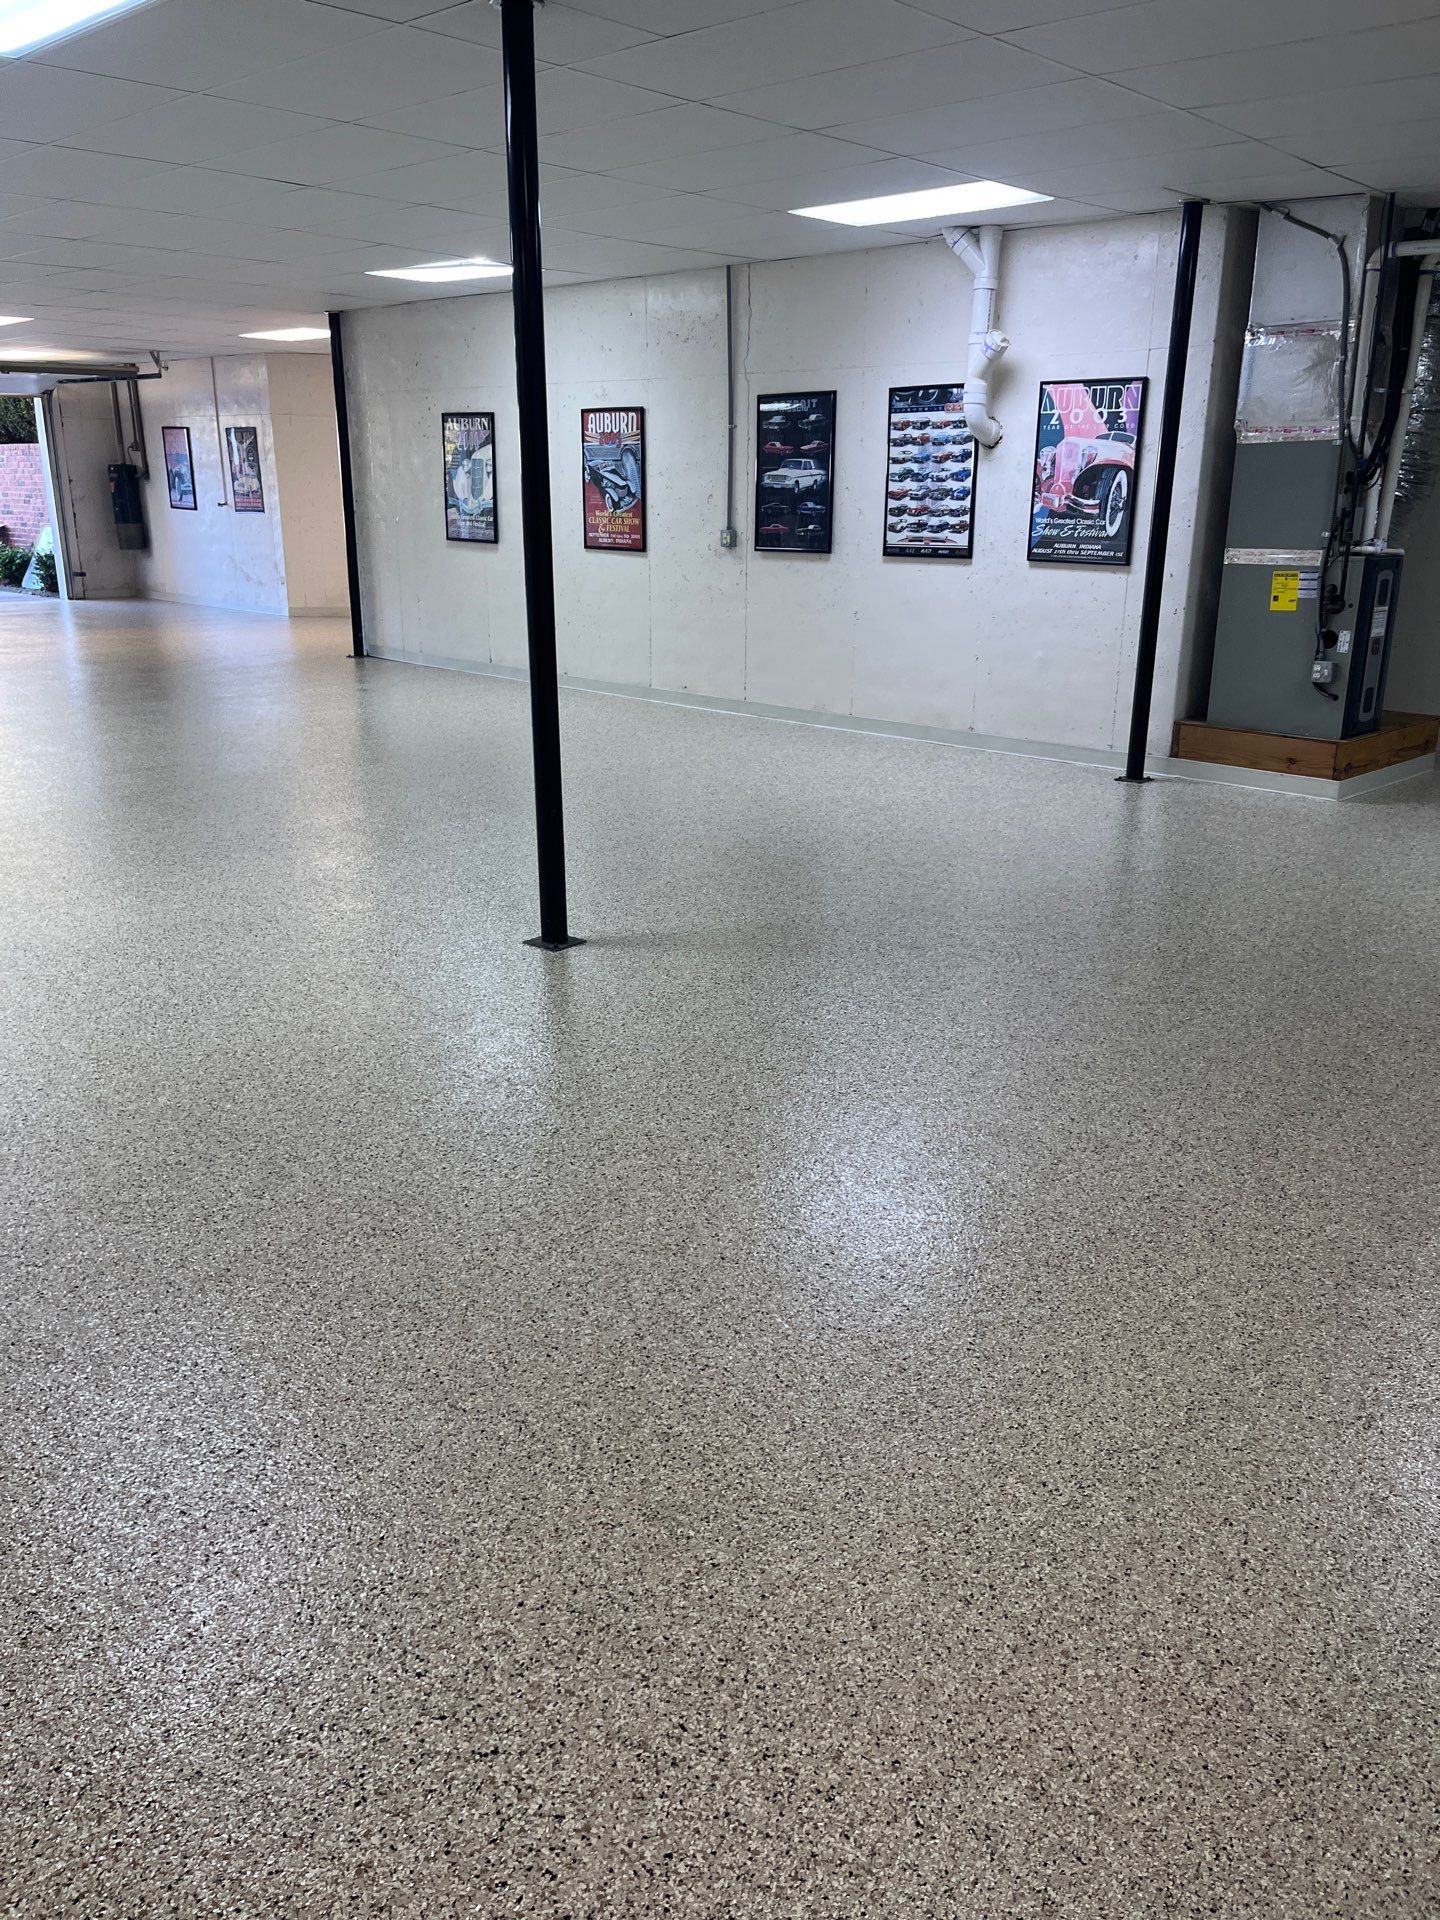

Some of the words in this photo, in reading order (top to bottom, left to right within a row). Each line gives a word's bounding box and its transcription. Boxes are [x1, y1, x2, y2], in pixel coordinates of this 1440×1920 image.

[1041, 384, 1142, 413] AUBURN
[588, 412, 637, 433] AUBURN
[1050, 407, 1127, 425] 2003
[446, 417, 489, 431] AUBURN
[588, 516, 611, 524] CLASSIC
[623, 518, 640, 526] SHOW
[598, 523, 606, 534] &
[1032, 524, 1060, 537] Show
[1060, 525, 1075, 537] &
